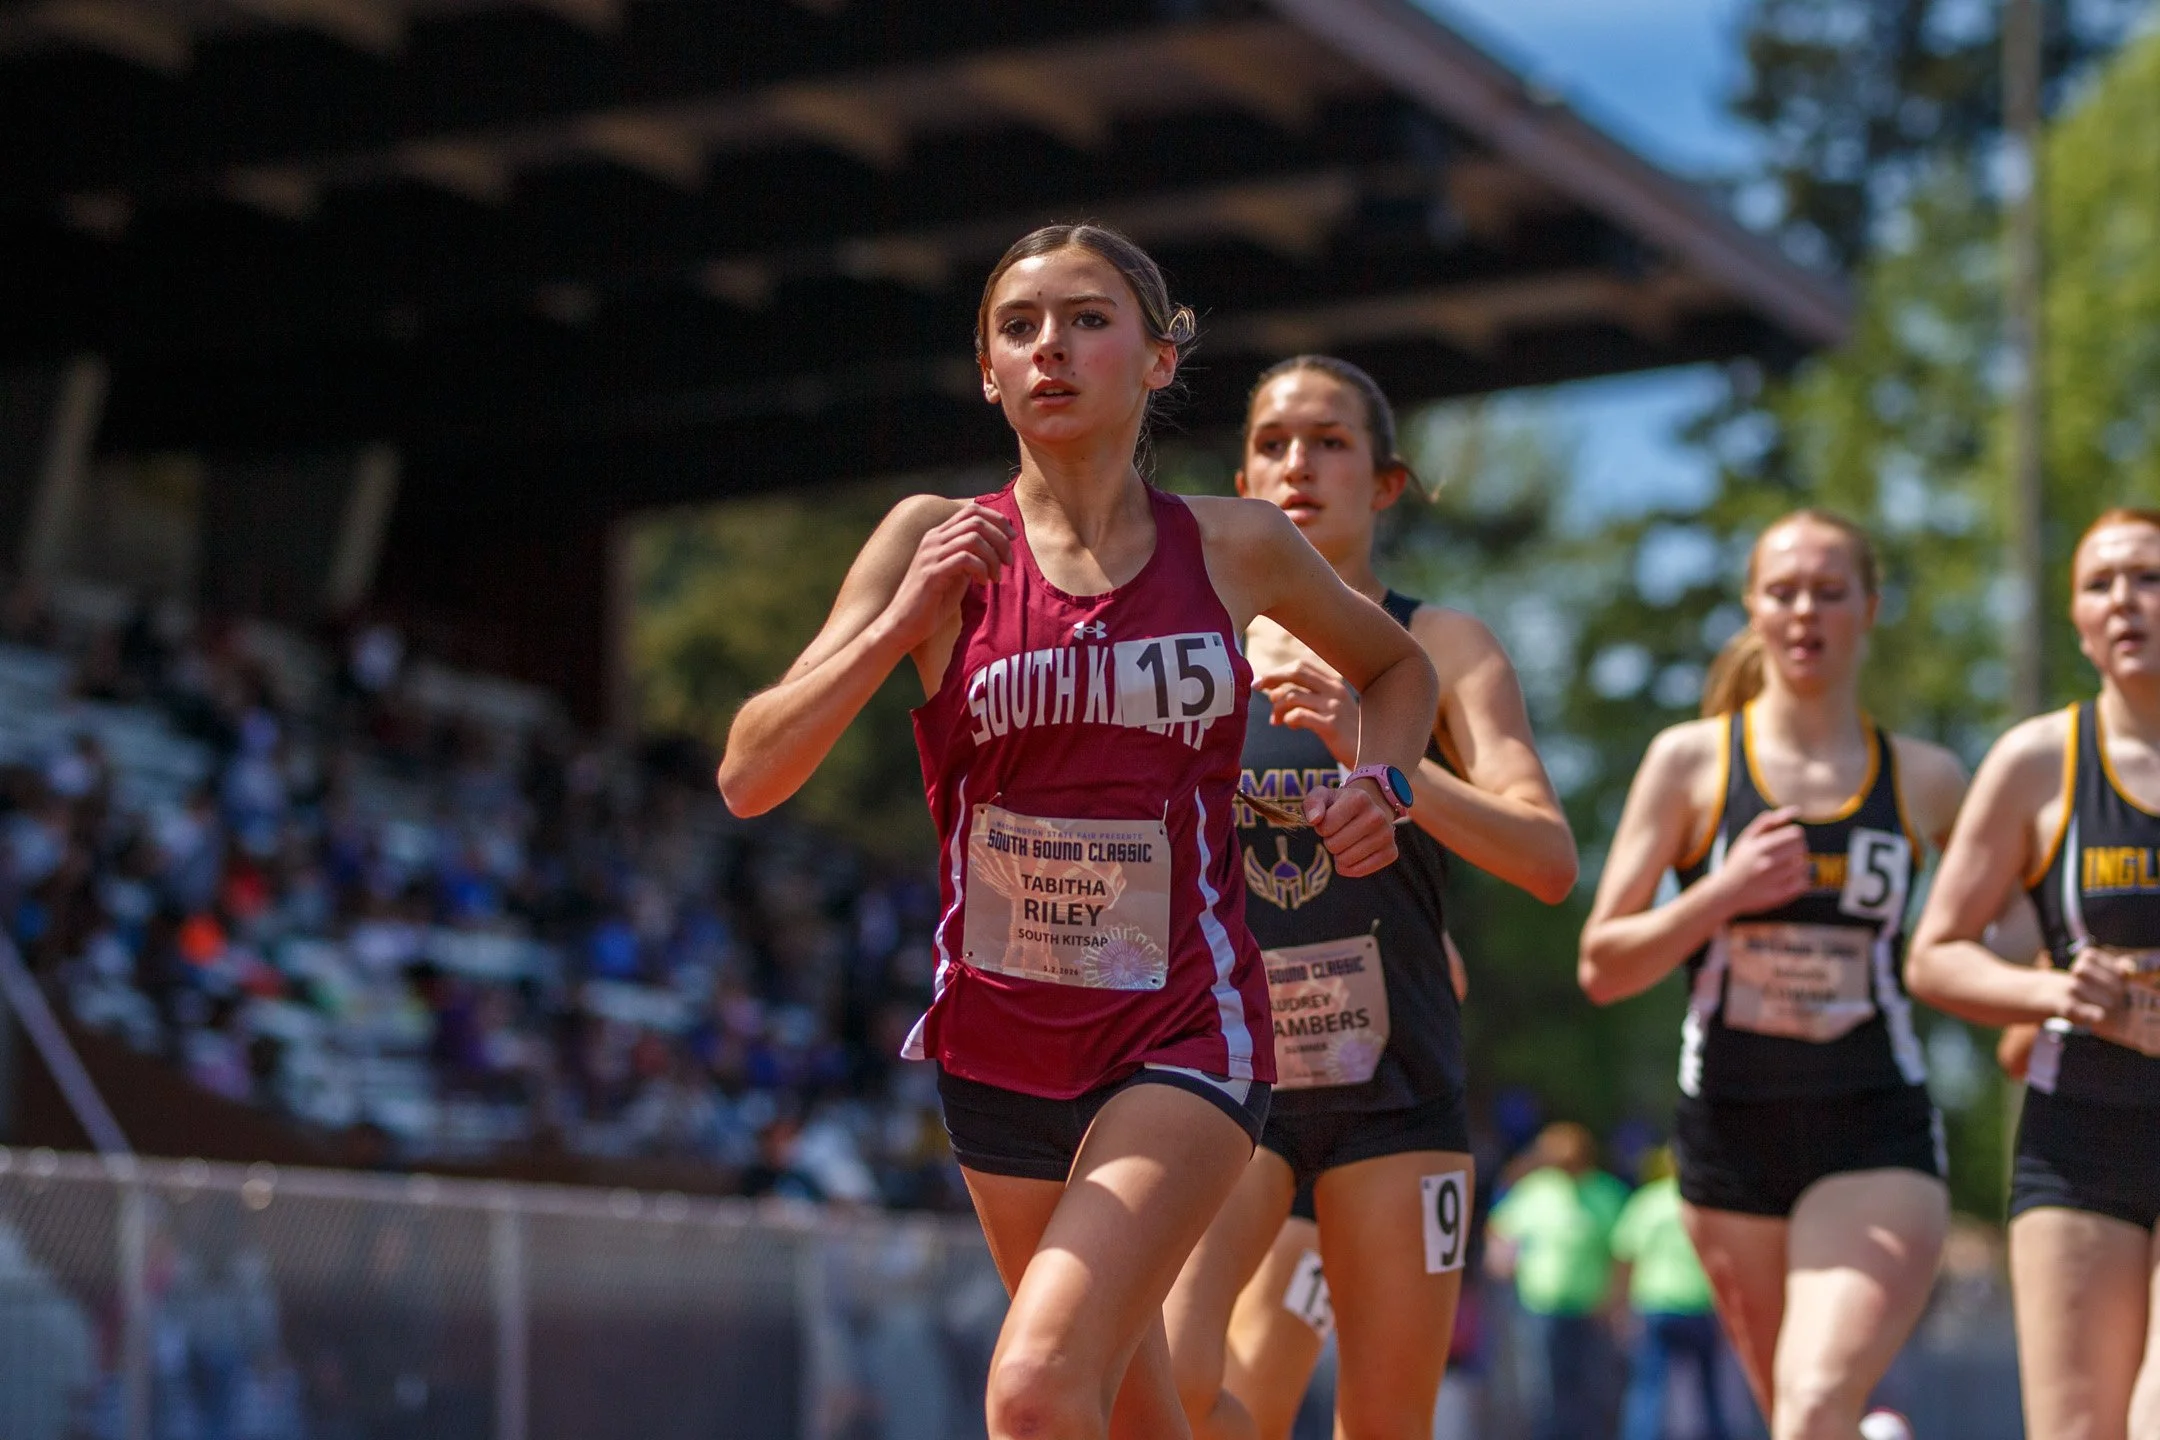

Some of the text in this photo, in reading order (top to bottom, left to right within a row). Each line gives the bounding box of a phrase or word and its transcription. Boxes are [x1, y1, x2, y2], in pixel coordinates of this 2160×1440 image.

[968, 647, 1076, 746] SOUTH
[1136, 637, 1215, 719] 15
[987, 828, 1152, 863] SOUTH SOUND CLASSIC
[1021, 873, 1106, 897] TABITHA
[1859, 840, 1897, 908] 5
[2082, 847, 2160, 890] INGL
[1024, 898, 1104, 927] RILEY
[1018, 928, 1108, 948] SOUTH KITSAP
[1273, 1008, 1370, 1038] AMBERS
[1437, 1179, 1460, 1267] 9
